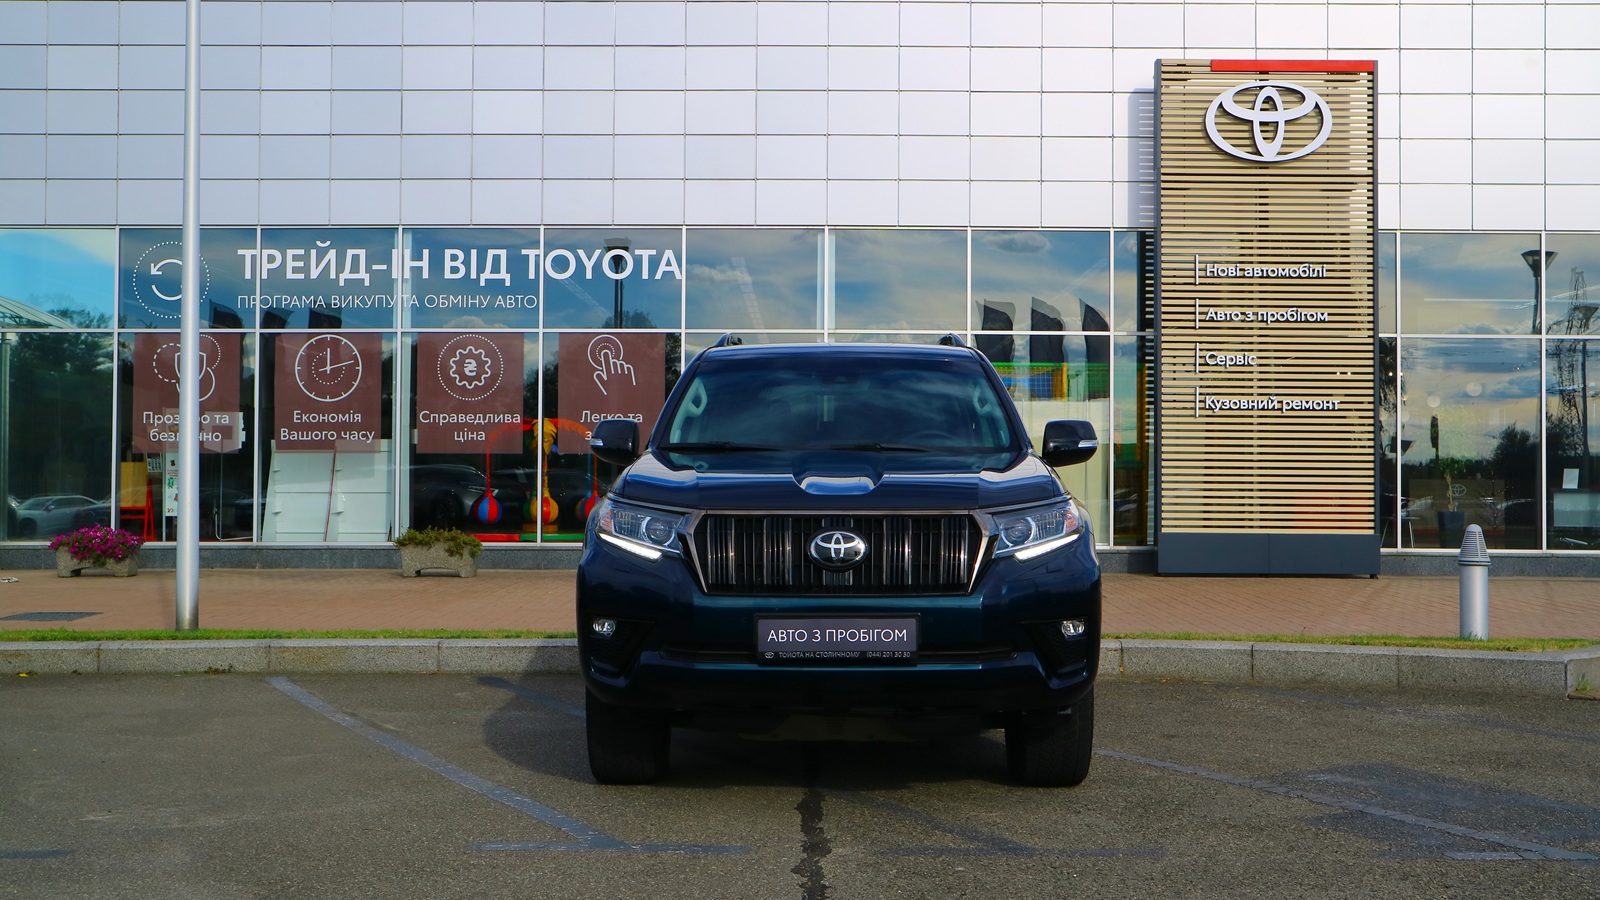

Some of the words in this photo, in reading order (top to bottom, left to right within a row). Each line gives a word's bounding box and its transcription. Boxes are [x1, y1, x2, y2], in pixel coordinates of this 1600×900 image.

[237, 240, 429, 286] ТРЕЙД-ІН
[444, 249, 511, 286] ВІД
[521, 248, 682, 279] TOYOTA
[1205, 263, 1240, 278] Нові
[1244, 263, 1327, 278] автомобілі
[237, 295, 327, 309] ПРОГРАМА
[331, 294, 397, 308] ВИКУПУ
[401, 294, 420, 308] ТА
[424, 294, 490, 308] ОБМІНУ
[494, 295, 538, 309] АВТО
[1205, 308, 1241, 322] Авто
[1245, 312, 1254, 322] з
[1257, 308, 1329, 325] пробігом
[1205, 352, 1257, 369] Сервіс
[1205, 396, 1278, 413] Кузовний
[1282, 399, 1341, 414] ремонт
[214, 414, 230, 424] та
[293, 410, 362, 423] Економія
[419, 410, 521, 426] Справедлива
[280, 428, 337, 441] Вашого
[341, 430, 375, 443] часу
[454, 429, 486, 442] ціна
[767, 629, 808, 642] АВТО
[812, 629, 822, 642] З
[826, 629, 908, 642] ПРОБІГОМ
